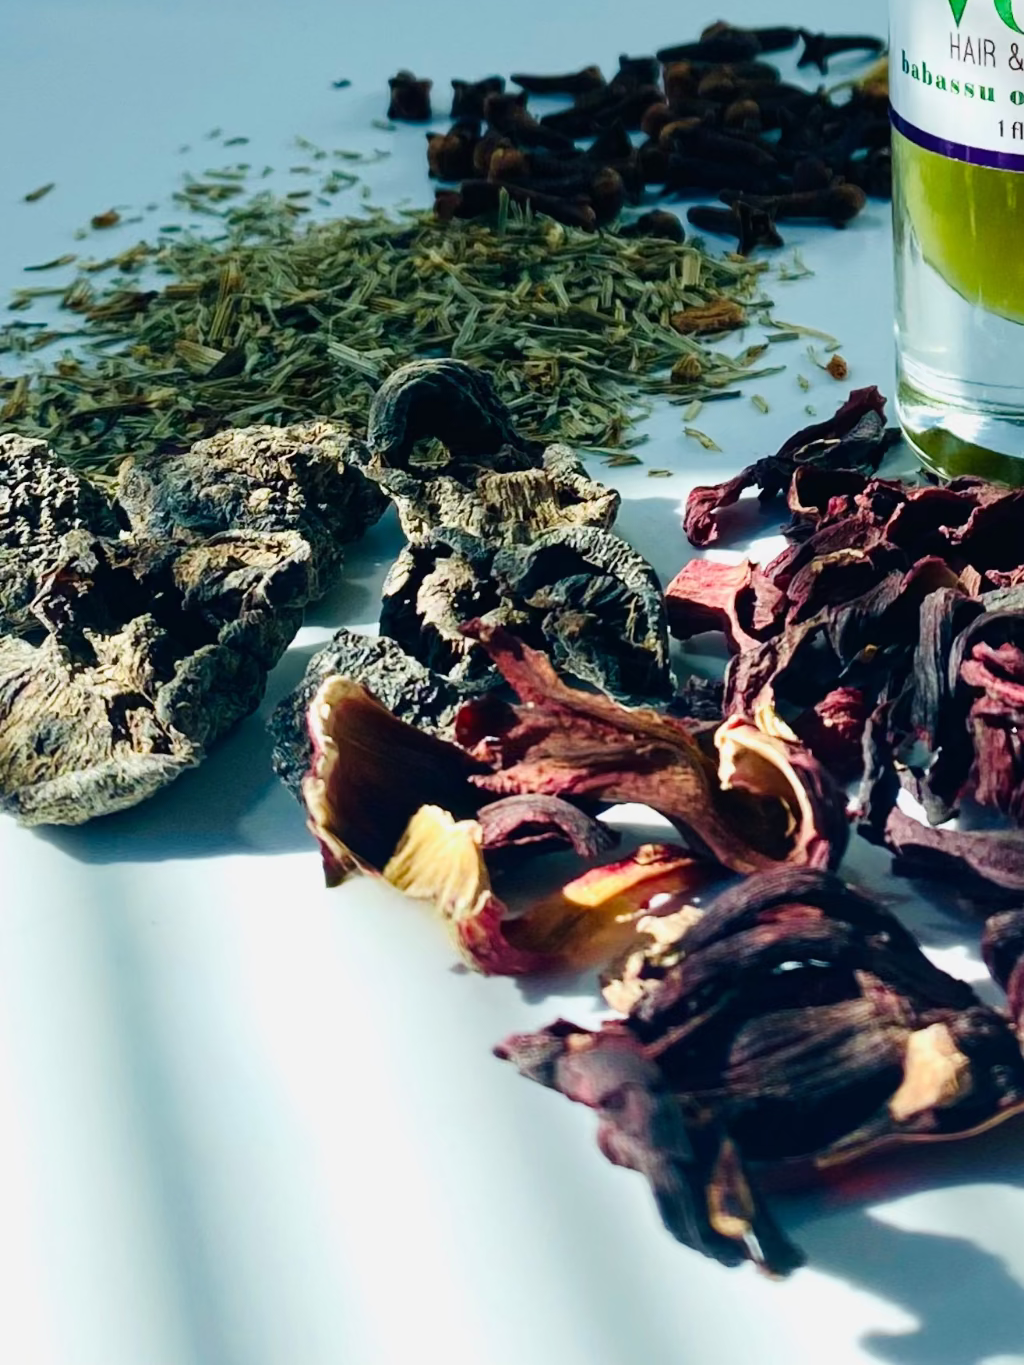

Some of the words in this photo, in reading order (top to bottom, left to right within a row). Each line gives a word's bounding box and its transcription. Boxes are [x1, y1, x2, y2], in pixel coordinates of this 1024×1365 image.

[950, 32, 996, 68] HAIR
[1008, 43, 1024, 71] &
[901, 49, 996, 102] babassu
[998, 120, 1004, 138] 1
